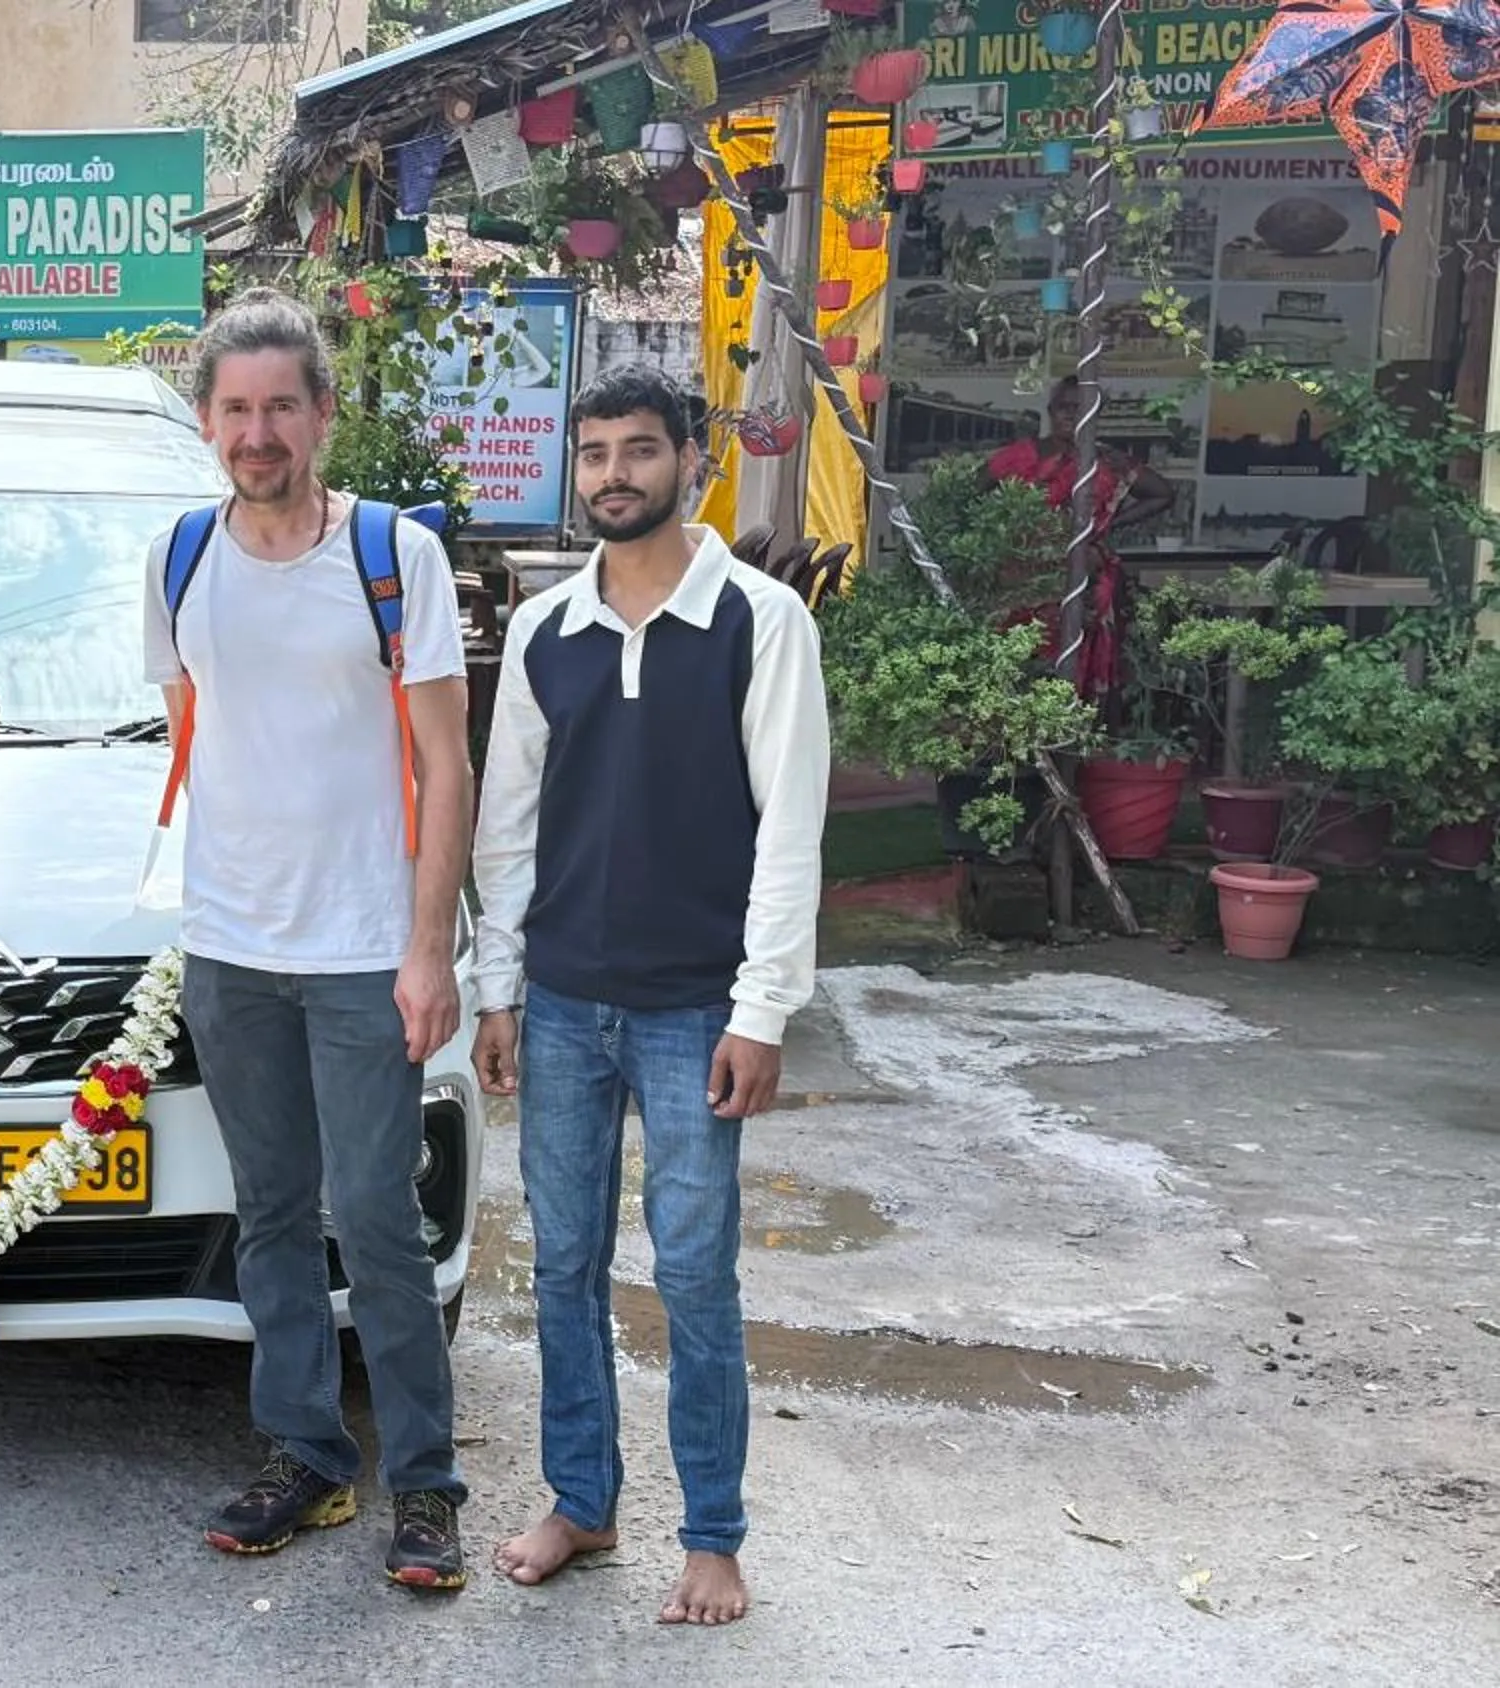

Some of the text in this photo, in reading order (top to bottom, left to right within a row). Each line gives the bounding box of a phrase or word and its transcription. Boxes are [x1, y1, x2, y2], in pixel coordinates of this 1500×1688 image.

[1155, 71, 1211, 95] NON
[7, 193, 193, 255] PARADISE
[482, 416, 556, 434] HANDS
[479, 439, 535, 457] HERE
